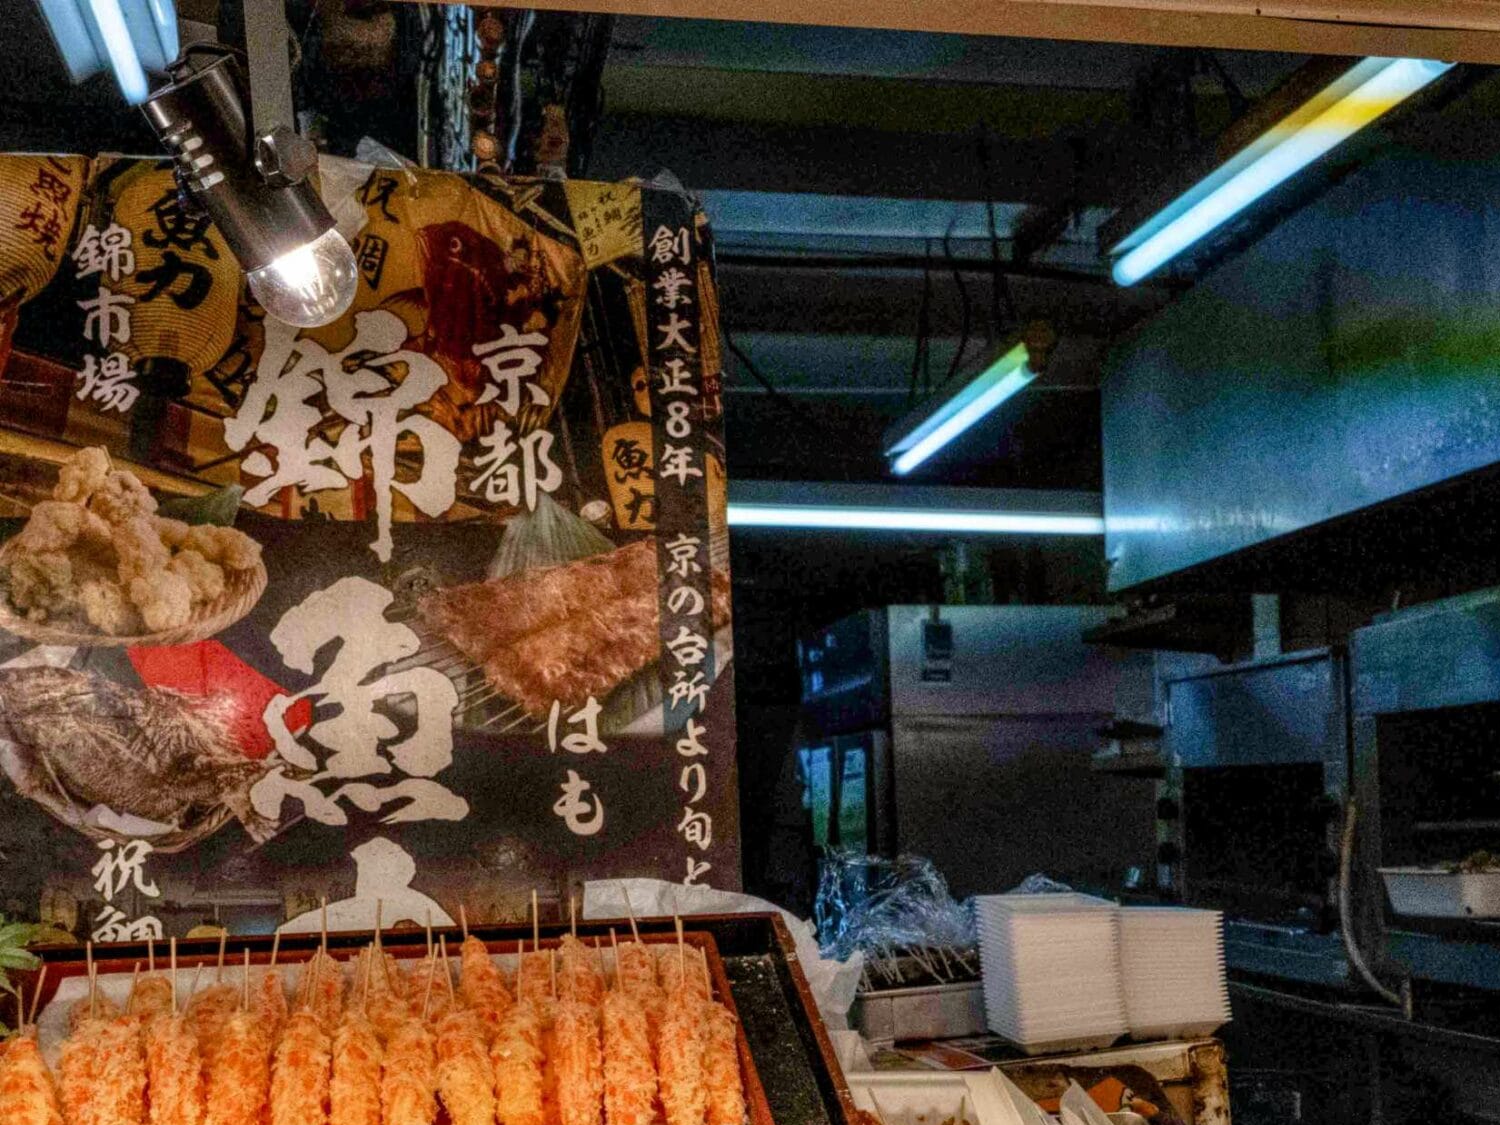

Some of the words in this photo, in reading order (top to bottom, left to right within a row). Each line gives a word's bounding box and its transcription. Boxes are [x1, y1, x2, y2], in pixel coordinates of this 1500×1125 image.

[72, 224, 141, 413] 錦市場
[648, 224, 703, 487] 創業大正8年
[469, 323, 563, 512] 京都
[547, 696, 608, 836] はも
